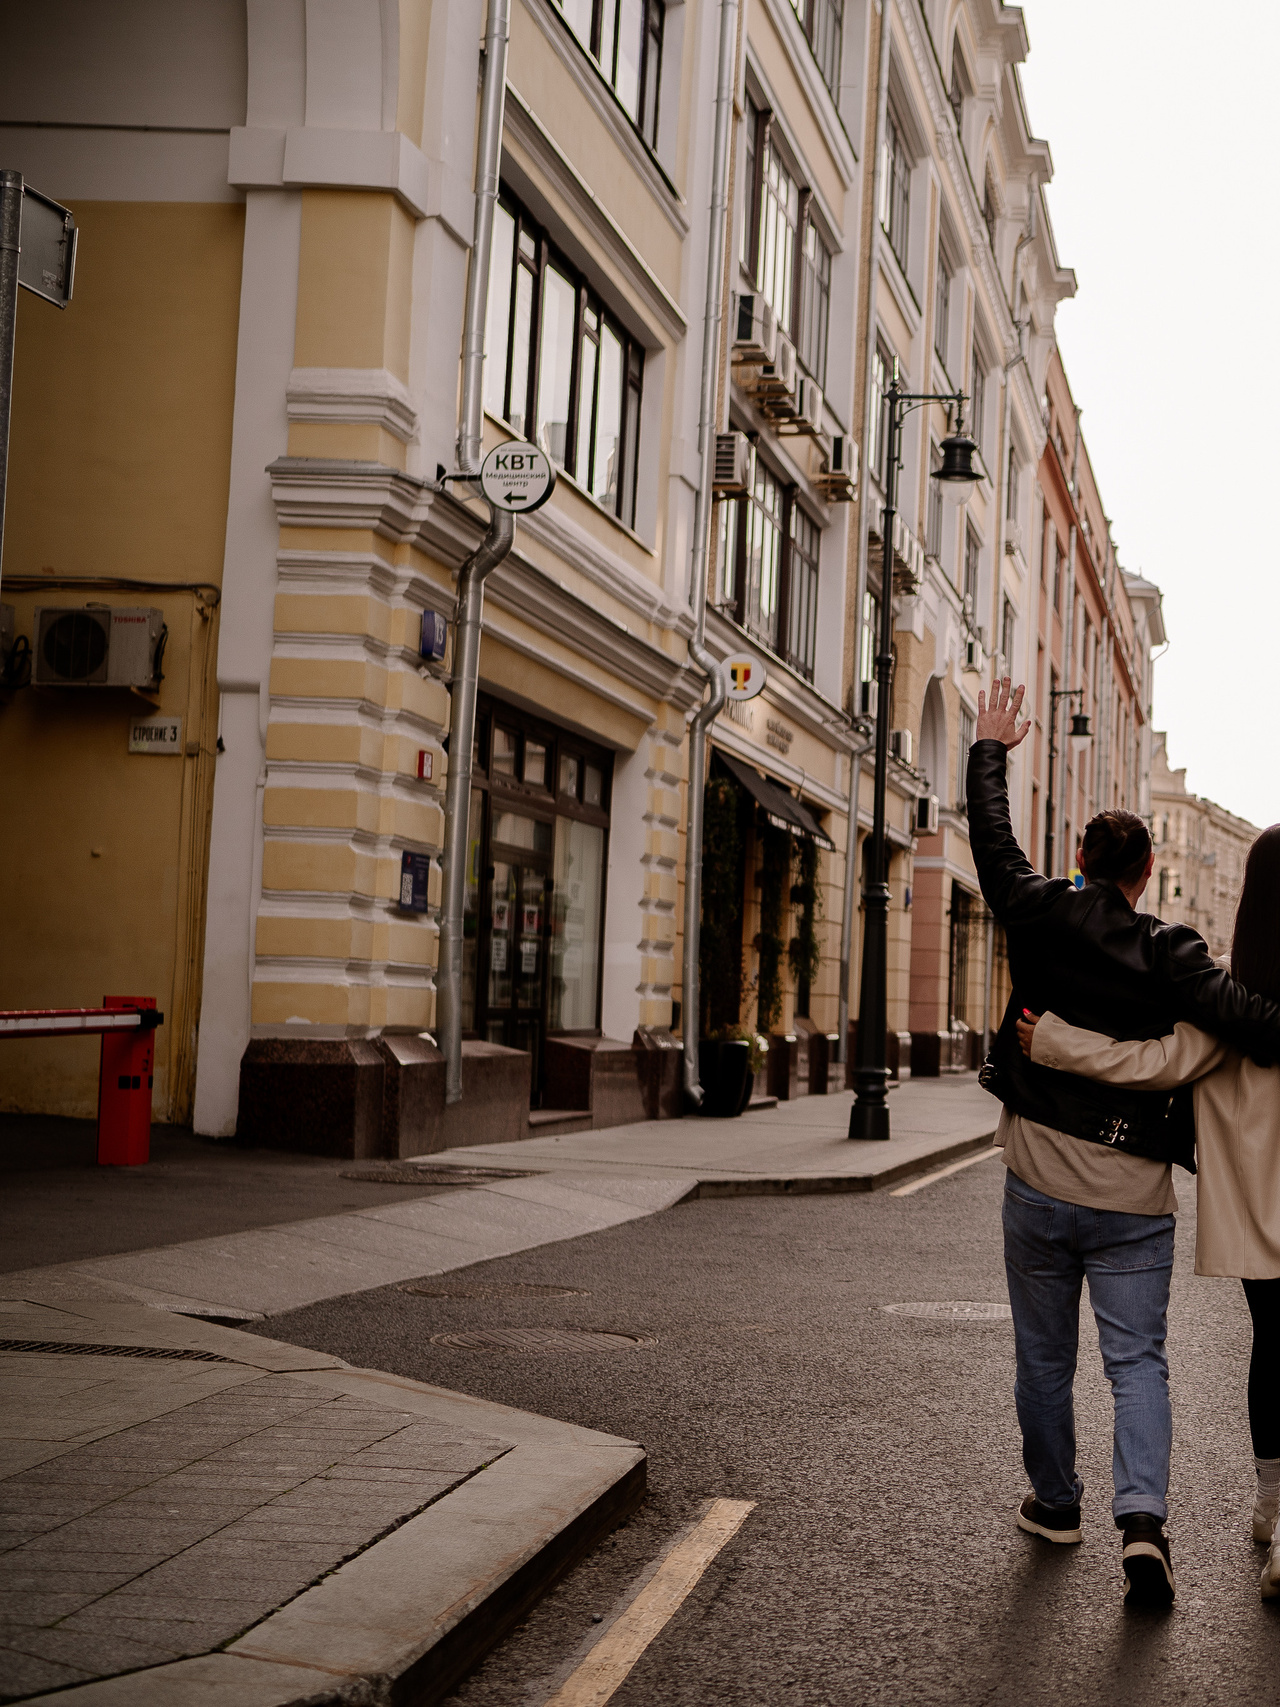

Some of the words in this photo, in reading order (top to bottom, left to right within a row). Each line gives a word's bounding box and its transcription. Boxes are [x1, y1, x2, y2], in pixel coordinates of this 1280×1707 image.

[495, 454, 538, 470] КВТ
[486, 471, 547, 480] Медицинский
[133, 726, 168, 742] СТРОЕНИЕ
[170, 725, 177, 742] 3
